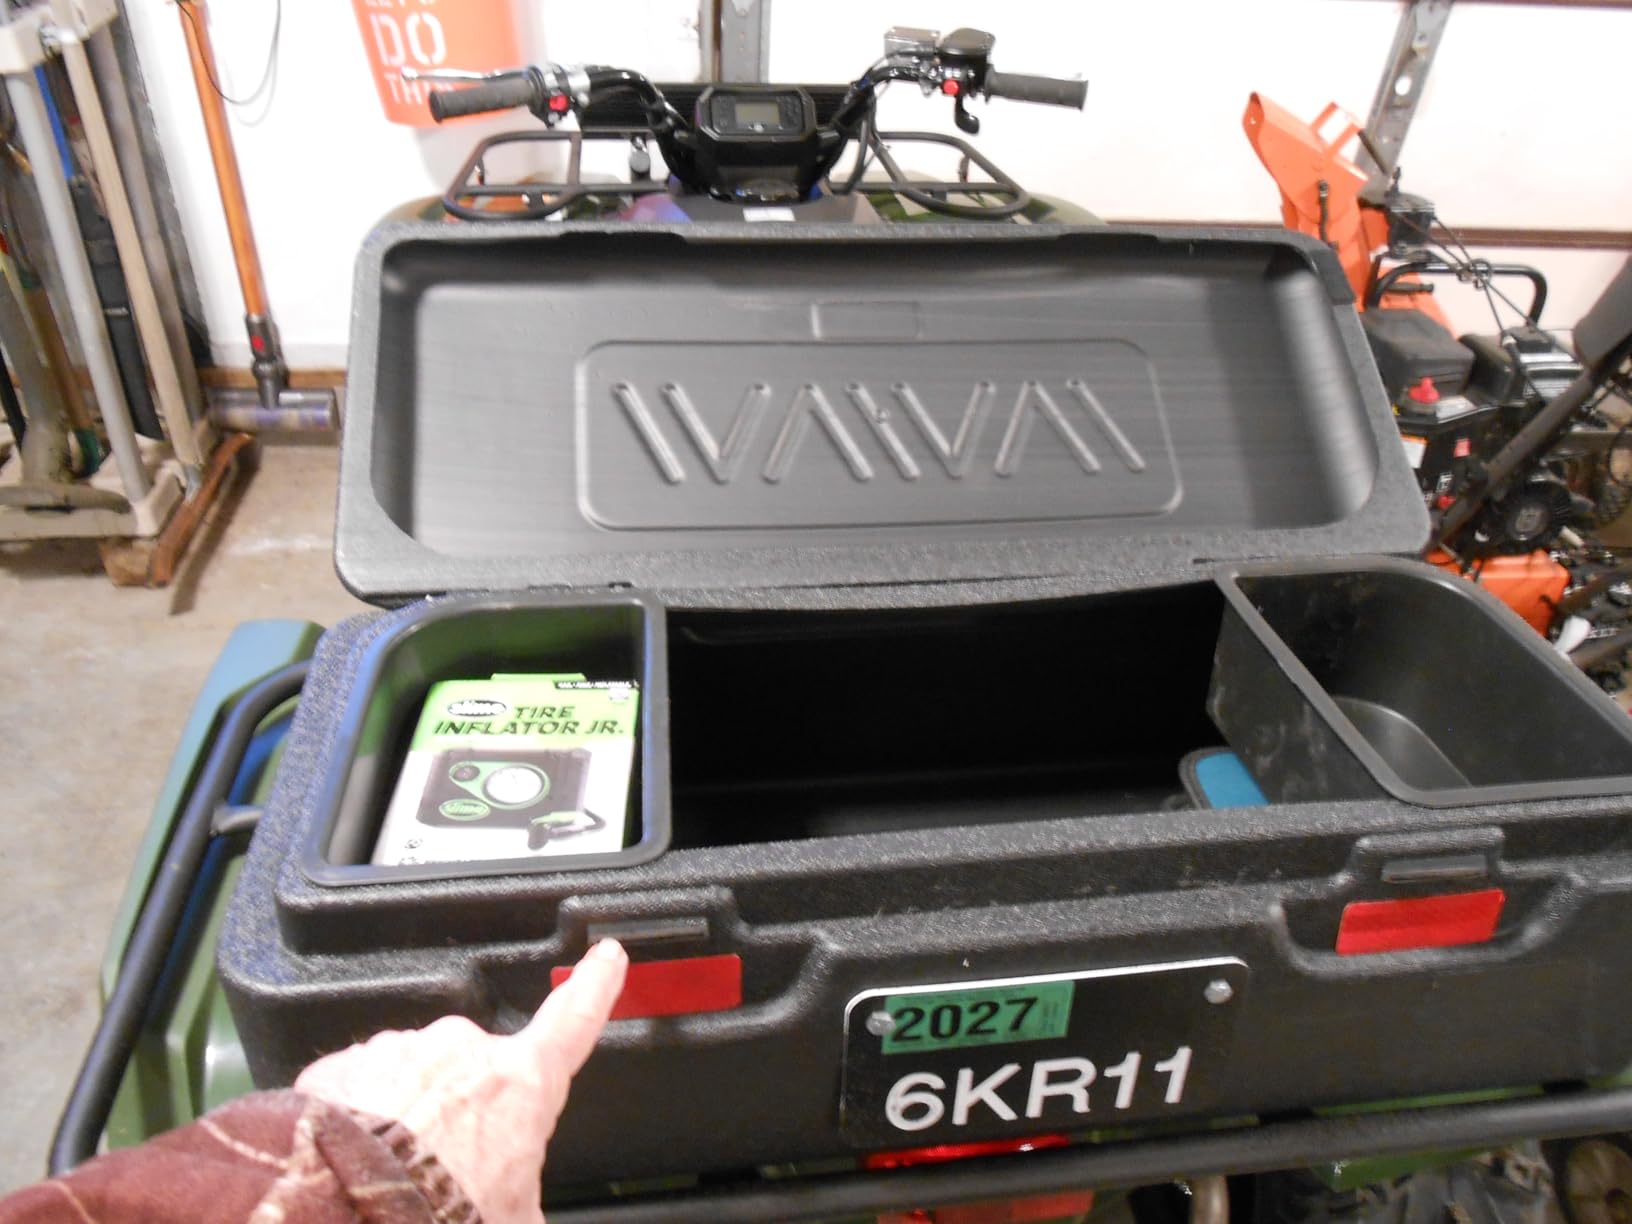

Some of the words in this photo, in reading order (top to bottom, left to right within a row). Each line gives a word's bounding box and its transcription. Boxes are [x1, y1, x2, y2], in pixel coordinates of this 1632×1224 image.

[370, 12, 446, 66] DO
[434, 720, 579, 735] INFLATOR
[585, 719, 624, 735] JR.
[514, 705, 575, 719] TIRE
[892, 996, 1039, 1042] 2027
[885, 1046, 1192, 1131] 6KR11
